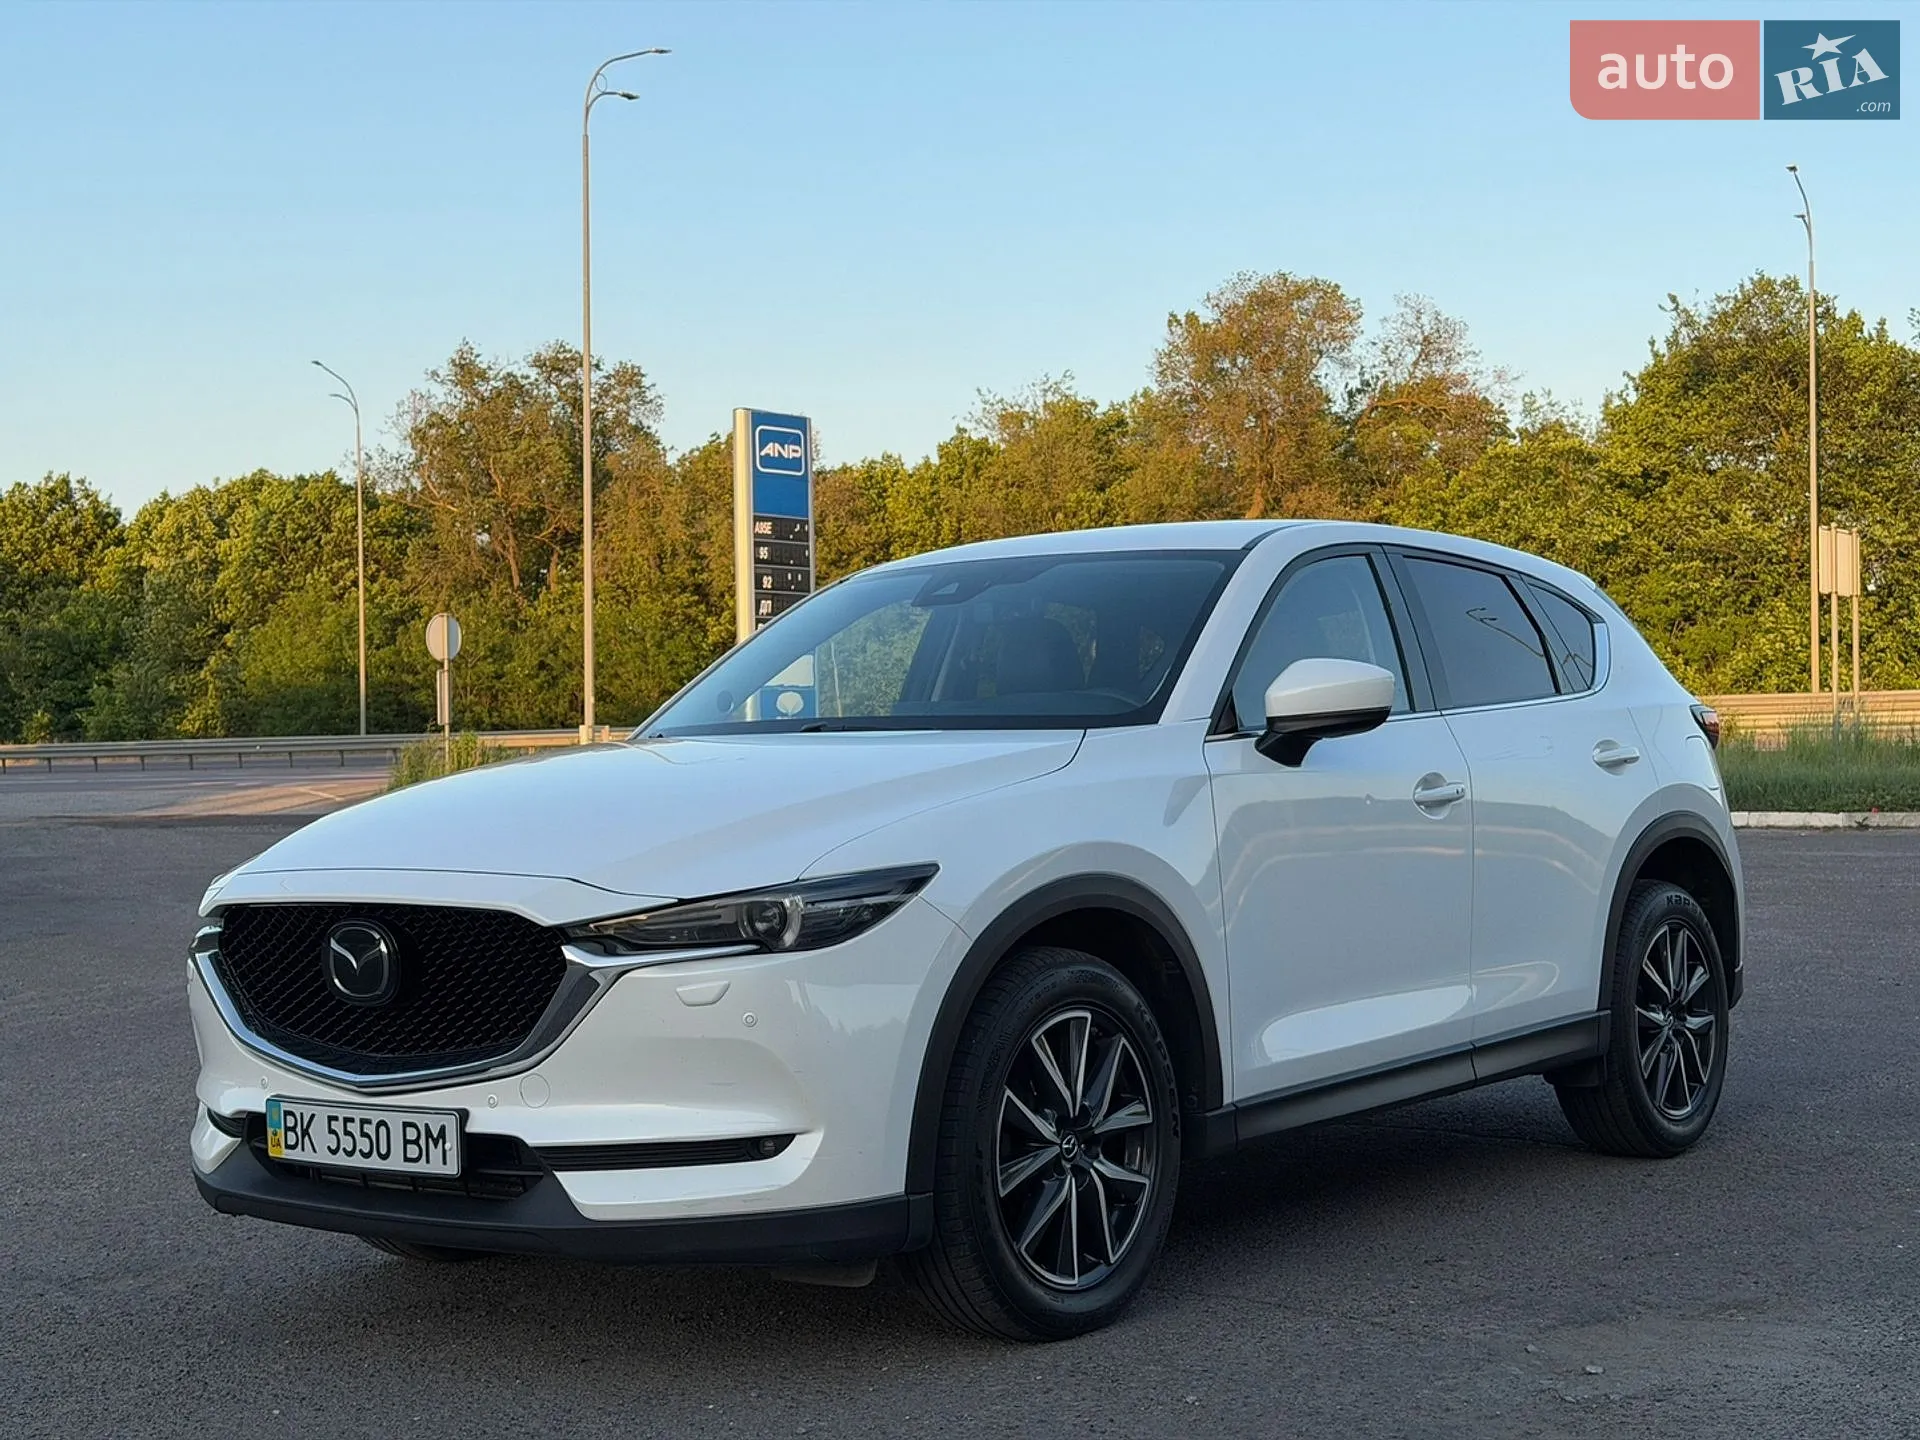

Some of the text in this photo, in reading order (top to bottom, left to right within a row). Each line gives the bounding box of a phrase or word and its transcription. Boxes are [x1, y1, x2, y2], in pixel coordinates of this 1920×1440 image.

[759, 442, 802, 459] ANP
[762, 575, 773, 589] 92
[270, 1137, 282, 1149] UA
[283, 1110, 448, 1165] BK 5550 BM
